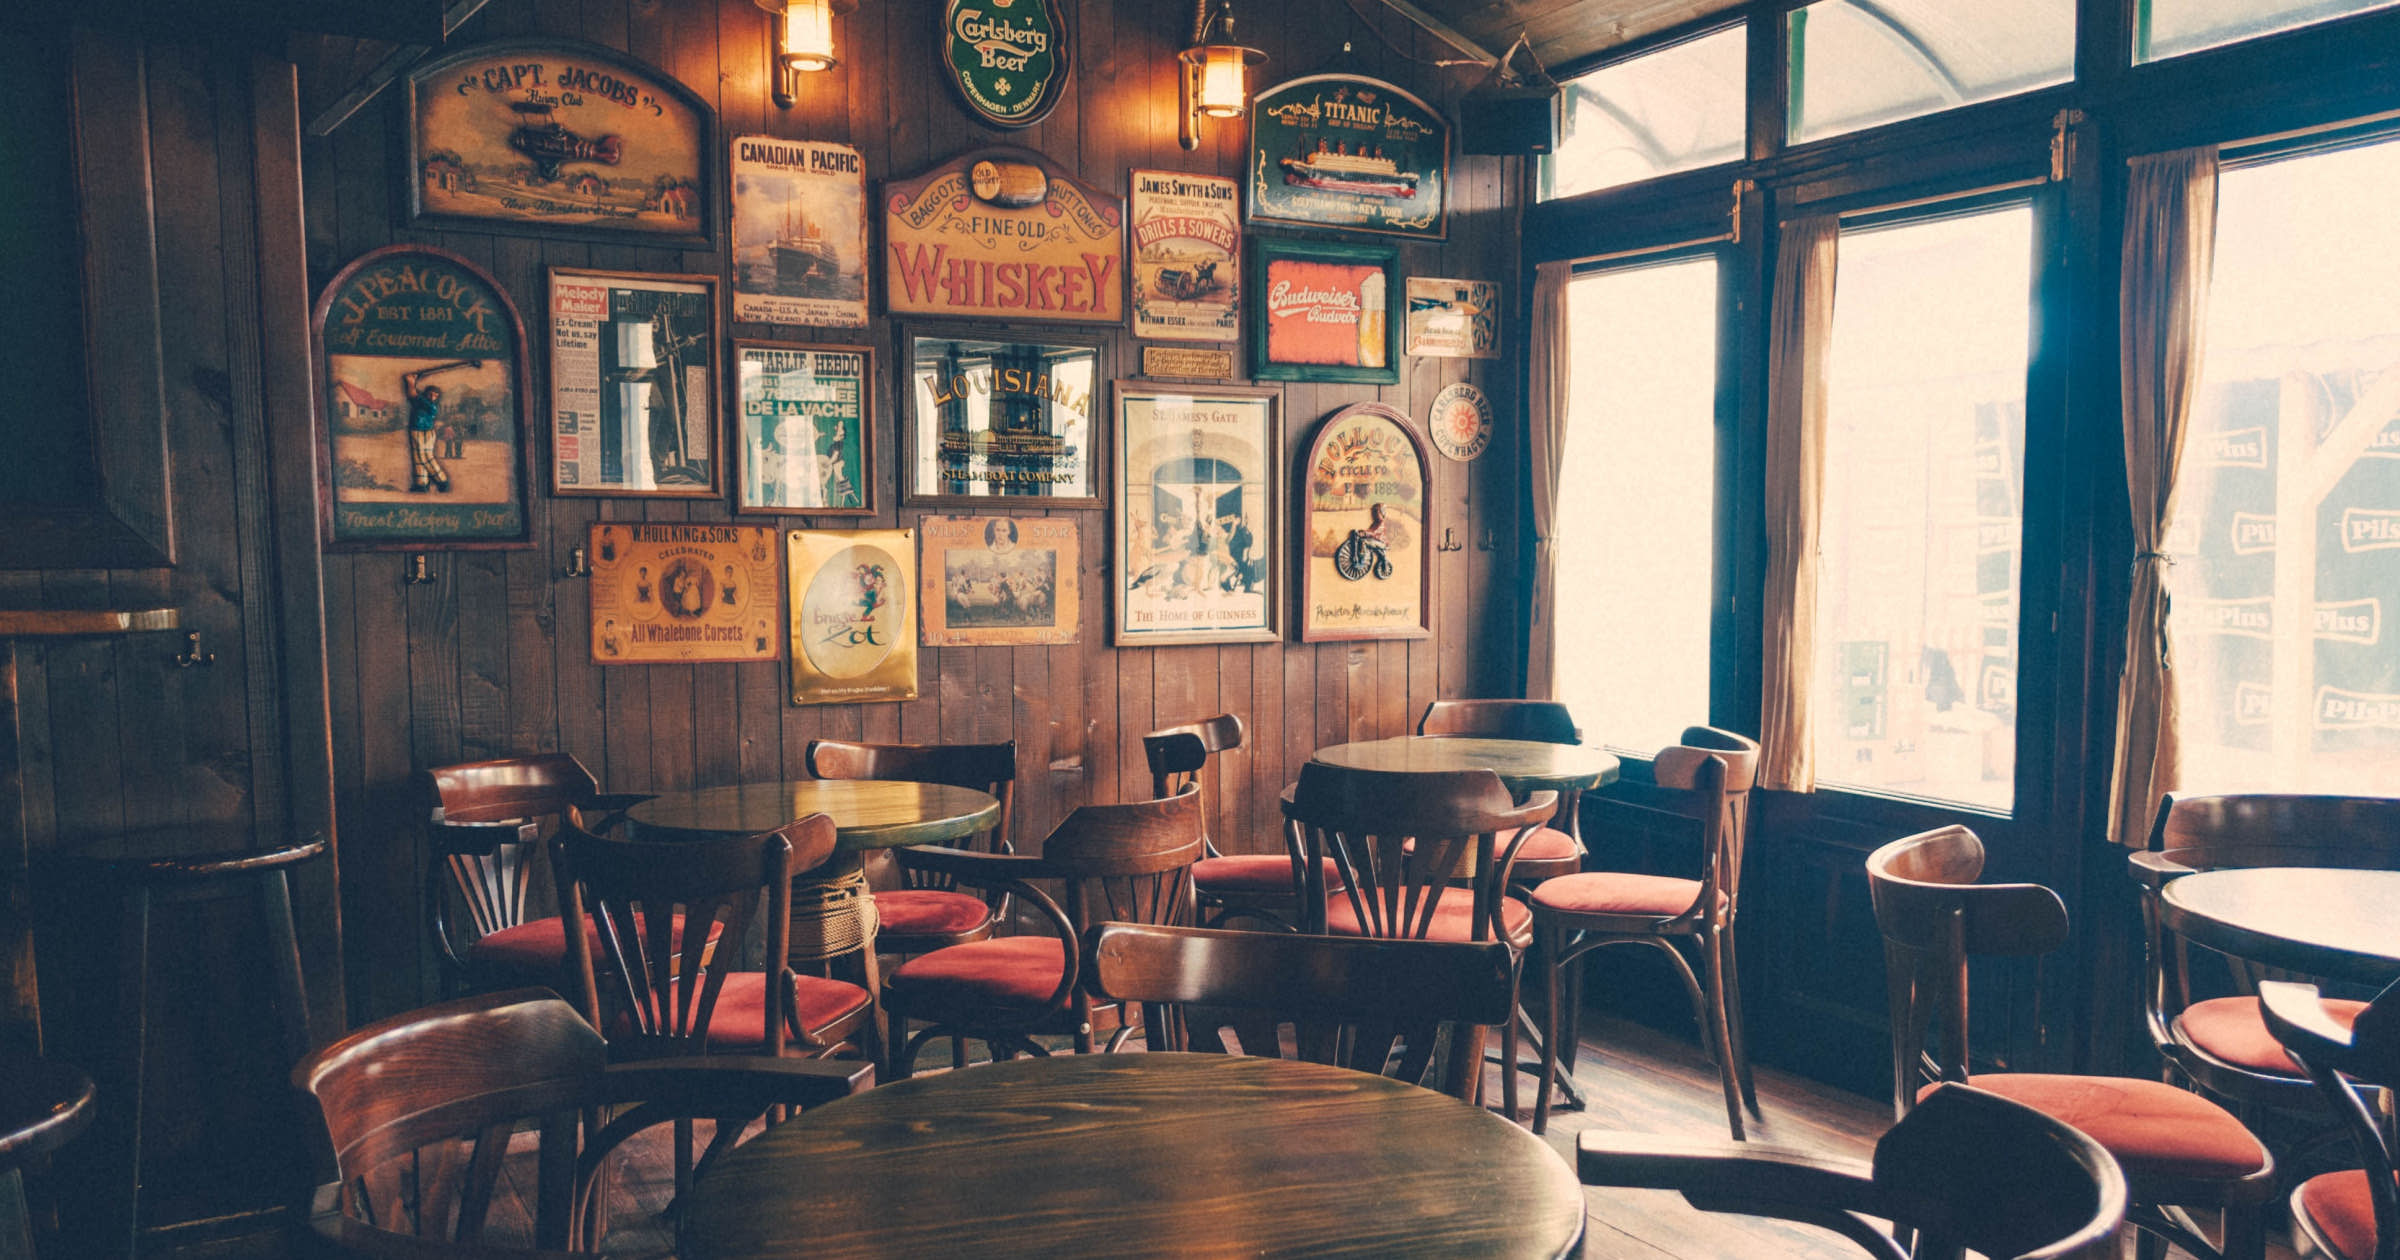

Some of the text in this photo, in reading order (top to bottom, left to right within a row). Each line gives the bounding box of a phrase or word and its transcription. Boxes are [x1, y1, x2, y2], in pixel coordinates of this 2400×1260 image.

[956, 9, 1047, 52] Carlsberg
[981, 46, 1028, 72] Beer
[484, 64, 639, 108] CAPT. JACOBS
[962, 71, 1006, 113] COPENHAGEN
[1324, 102, 1380, 124] TITANIC
[741, 143, 858, 173] CANADIAN PACIFIC
[1140, 176, 1170, 195] JAMES
[1173, 179, 1203, 198] SMYTH
[1211, 183, 1232, 200] SONS
[911, 177, 964, 226] BAGGOTS
[972, 217, 1046, 238] FINE OLD
[1139, 219, 1233, 249] DRILLS & SOWERS
[890, 244, 1121, 313] WHISKEY
[556, 286, 605, 300] Melody
[1269, 280, 1360, 309] Budweiser
[378, 306, 411, 320] EST
[561, 299, 600, 312] Maker
[1307, 306, 1359, 323] Budvar
[556, 339, 587, 348] Lifetime
[814, 354, 860, 376] HEBDO
[924, 368, 1091, 416] LOUISIANA
[748, 401, 858, 418] DE LA VACHE
[1212, 410, 1238, 423] GATE
[1018, 471, 1075, 484] COMPANY
[671, 525, 698, 543] KING
[709, 526, 739, 543] SONS
[1033, 526, 1069, 538] STAR
[632, 624, 645, 643] All
[647, 623, 702, 643] Whalebone
[817, 625, 886, 648] Zot
